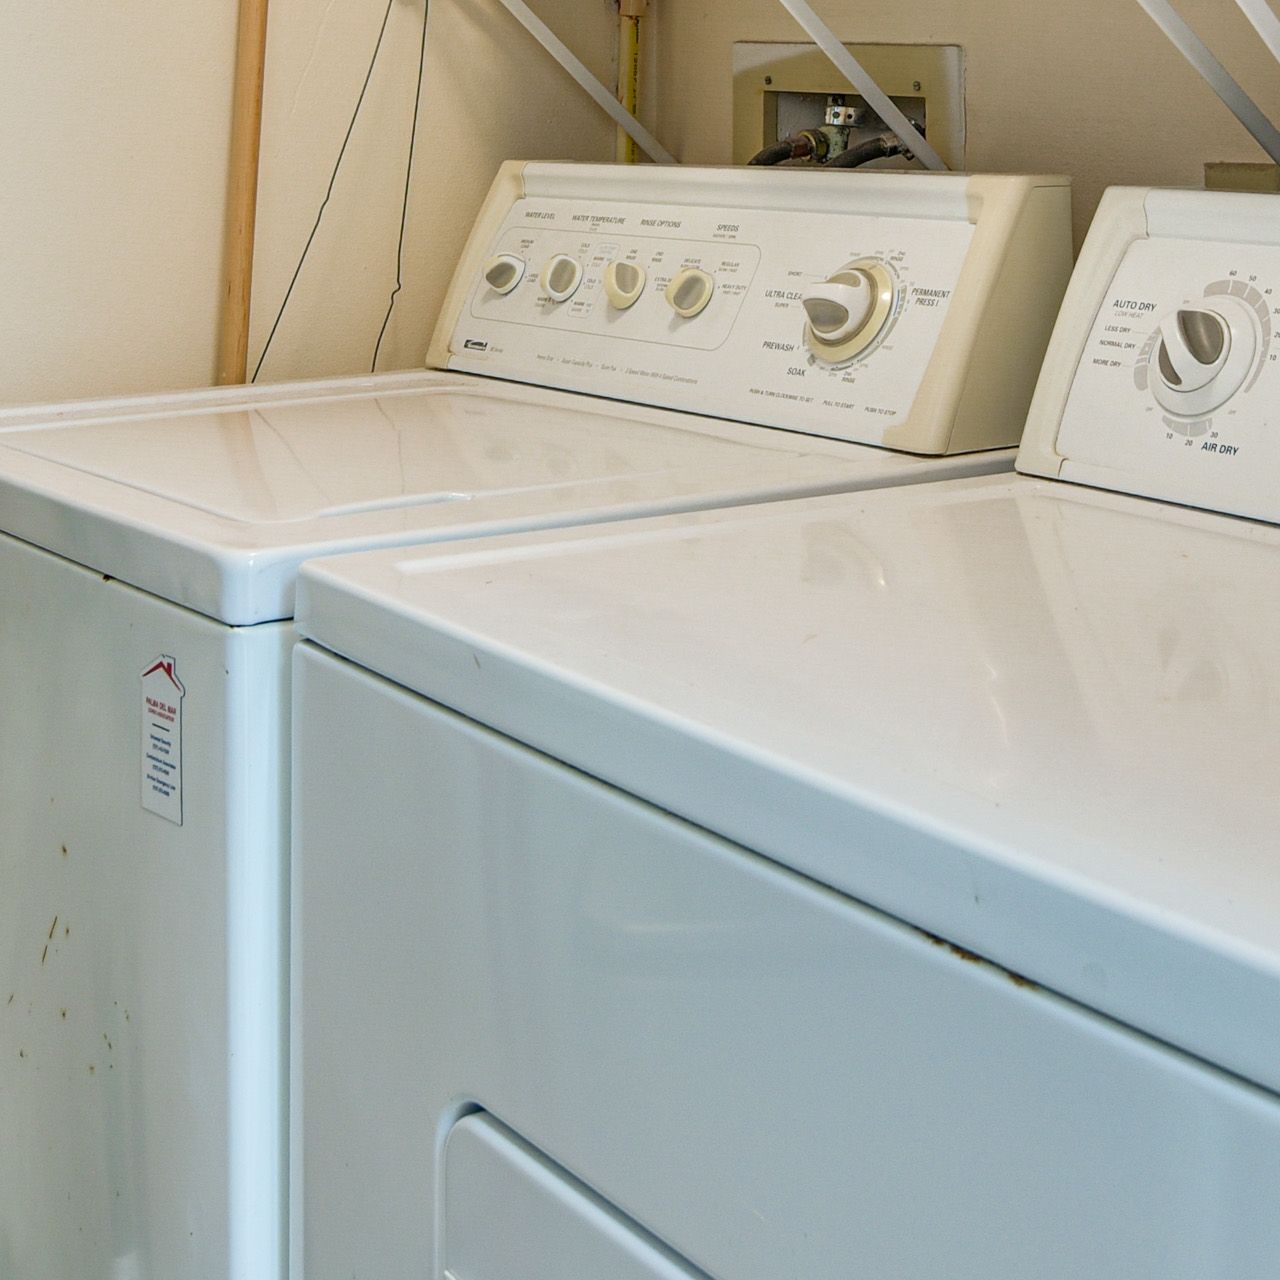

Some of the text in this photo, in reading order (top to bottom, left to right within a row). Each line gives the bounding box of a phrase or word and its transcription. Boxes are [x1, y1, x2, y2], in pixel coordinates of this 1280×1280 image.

[541, 212, 556, 220] LEVEL
[571, 214, 626, 225] WATER TEMPERATURE
[640, 218, 681, 229] RINSE OPTIONS
[716, 223, 740, 233] SPEEDS
[765, 290, 803, 301] ULTRA CLEA
[911, 288, 951, 299] PERMANENT
[915, 298, 934, 306] PRESS
[1113, 299, 1157, 312] AUTO DRY
[762, 340, 795, 352] PREWASH
[1099, 340, 1124, 348] NORMAL
[1092, 358, 1109, 366] MORE
[786, 367, 807, 377] SOAK
[822, 399, 833, 407] PULL
[840, 401, 855, 409] START
[884, 408, 897, 416] STOP
[1210, 431, 1219, 439] 30
[1184, 439, 1193, 447] 20
[1201, 441, 1239, 456] AIR DRY
